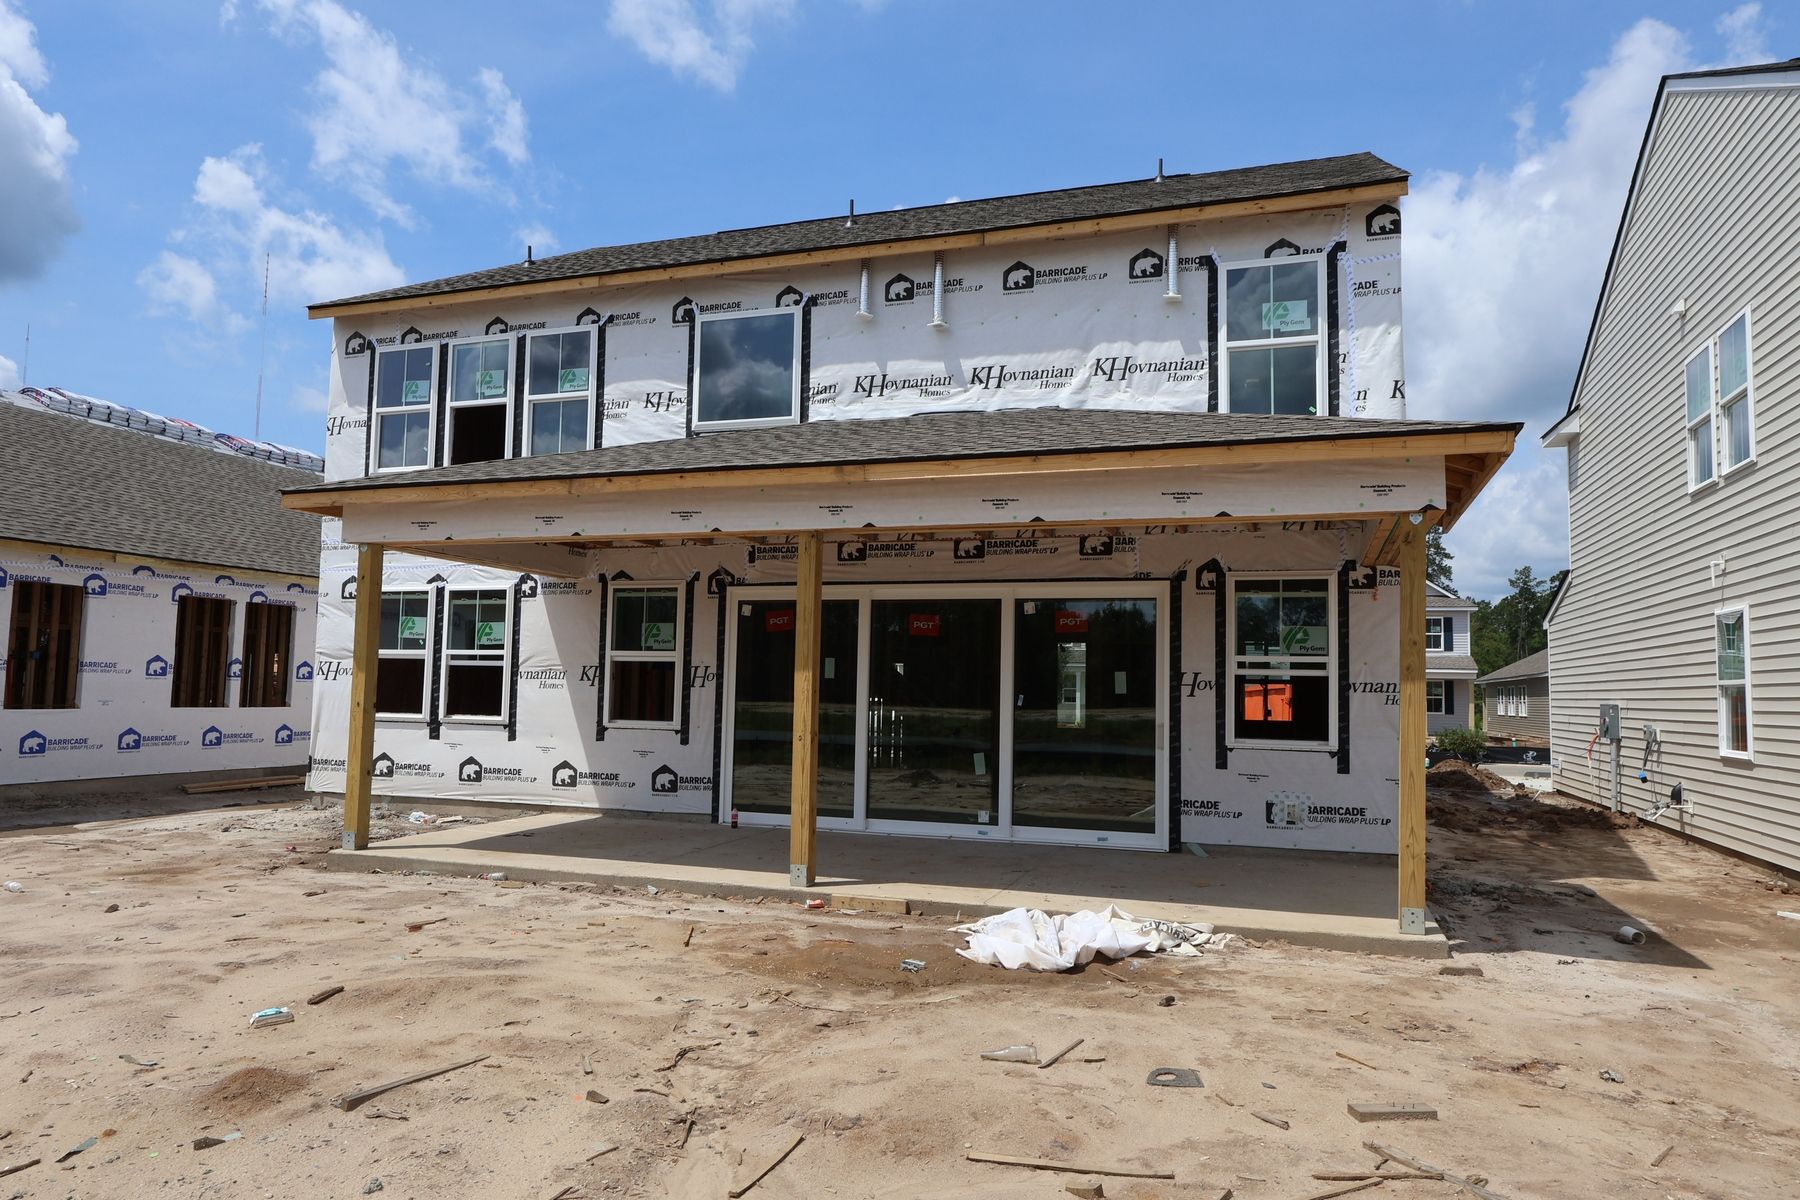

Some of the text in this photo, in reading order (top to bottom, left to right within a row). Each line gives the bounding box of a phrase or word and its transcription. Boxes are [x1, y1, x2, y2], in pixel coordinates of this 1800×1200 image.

[1035, 266, 1087, 279] BARRICADE
[1035, 272, 1108, 286] BUILDING WRAP PLUS LP
[1372, 288, 1390, 297] PLUS
[700, 301, 742, 312] BARRICADE
[649, 317, 657, 325] LP
[509, 321, 547, 332] BARRICADE
[423, 330, 459, 342] BARRICADE
[1167, 373, 1203, 383] Homes
[1039, 380, 1071, 390] Homes
[919, 388, 951, 398] Homes
[868, 543, 916, 552] BARRICADE
[987, 539, 1037, 549] BARRICADE
[867, 551, 893, 559] BUILDING
[926, 550, 934, 558] LP
[986, 548, 1014, 556] BUILDING
[1015, 547, 1031, 555] WRAP
[1032, 546, 1047, 554] PLUS
[108, 582, 145, 593] BARRICADE
[585, 588, 593, 596] LP
[769, 616, 789, 625] PGT
[913, 621, 933, 629] PGT
[79, 660, 117, 669] BARRICADE
[538, 681, 564, 689] Homes
[142, 735, 177, 743] BARRICADE
[223, 732, 254, 740] BARRICADE
[48, 738, 88, 746] BARRICADE
[312, 758, 346, 768] BARRICADE
[395, 763, 430, 772] BARRICADE
[483, 767, 522, 776] BARRICADE
[579, 771, 620, 782] BARRICADE
[1194, 810, 1213, 818] WRAP
[1213, 811, 1230, 819] PLUS
[1232, 811, 1243, 819] LP
[1338, 817, 1359, 825] WRAP
[1360, 817, 1380, 825] PLUS
[1381, 818, 1392, 826] LP
